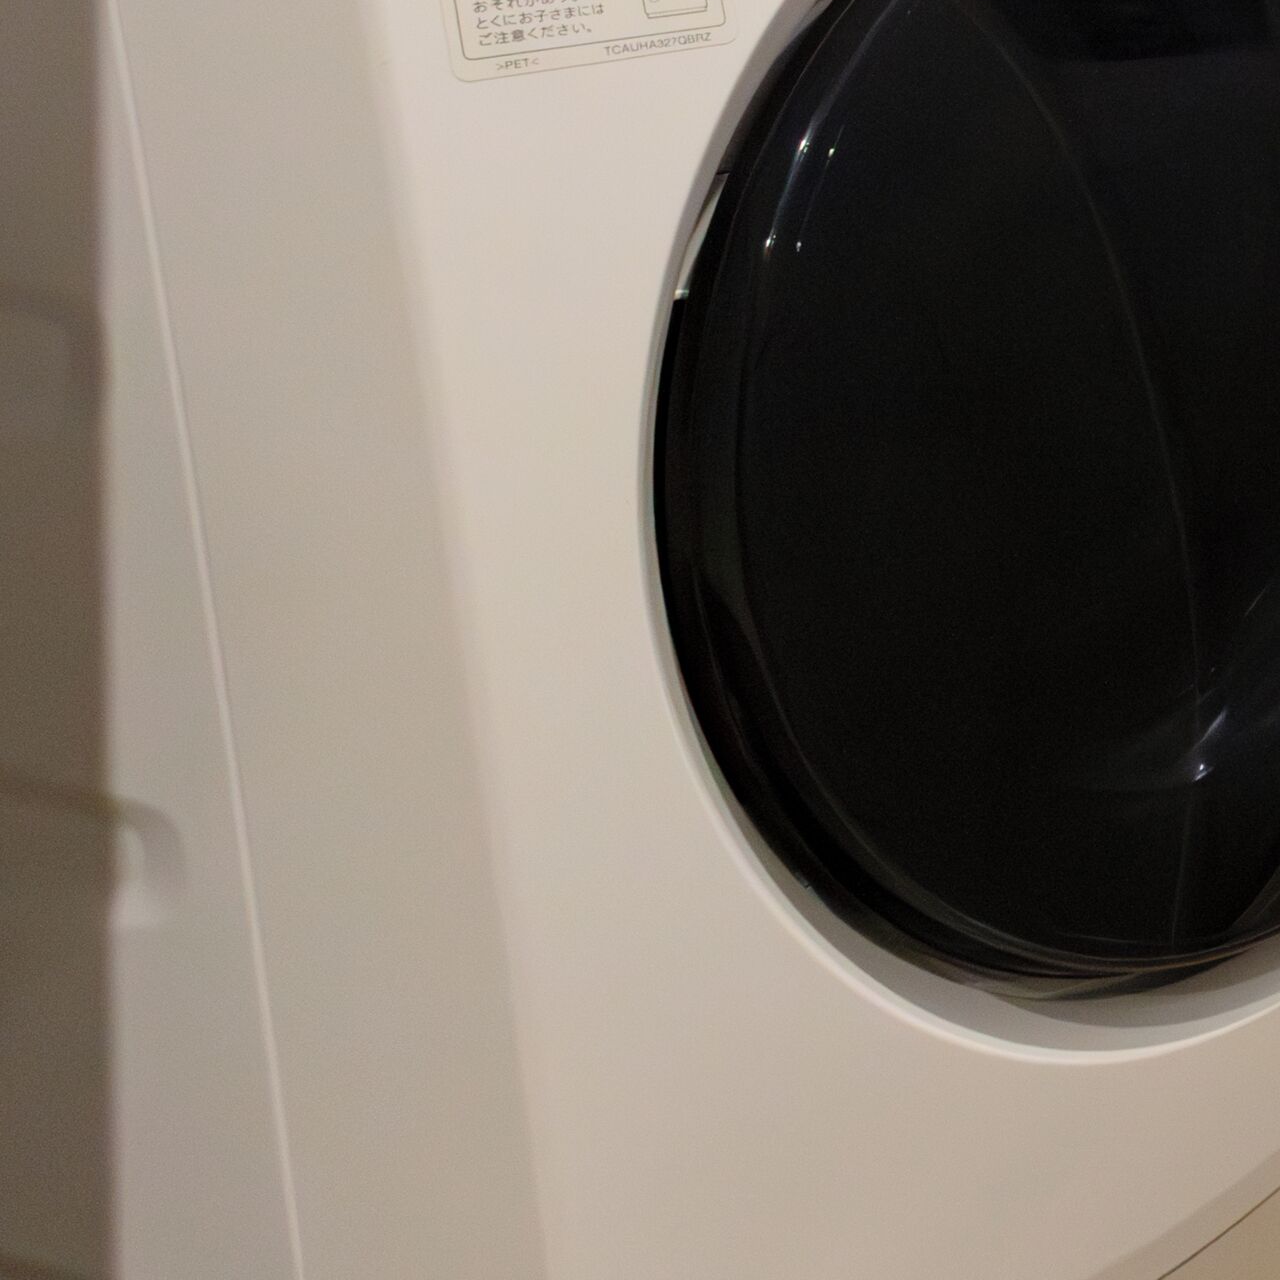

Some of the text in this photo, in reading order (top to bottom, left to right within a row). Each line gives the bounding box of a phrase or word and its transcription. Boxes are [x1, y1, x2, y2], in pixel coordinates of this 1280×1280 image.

[476, 4, 604, 29] とくにお子さまには
